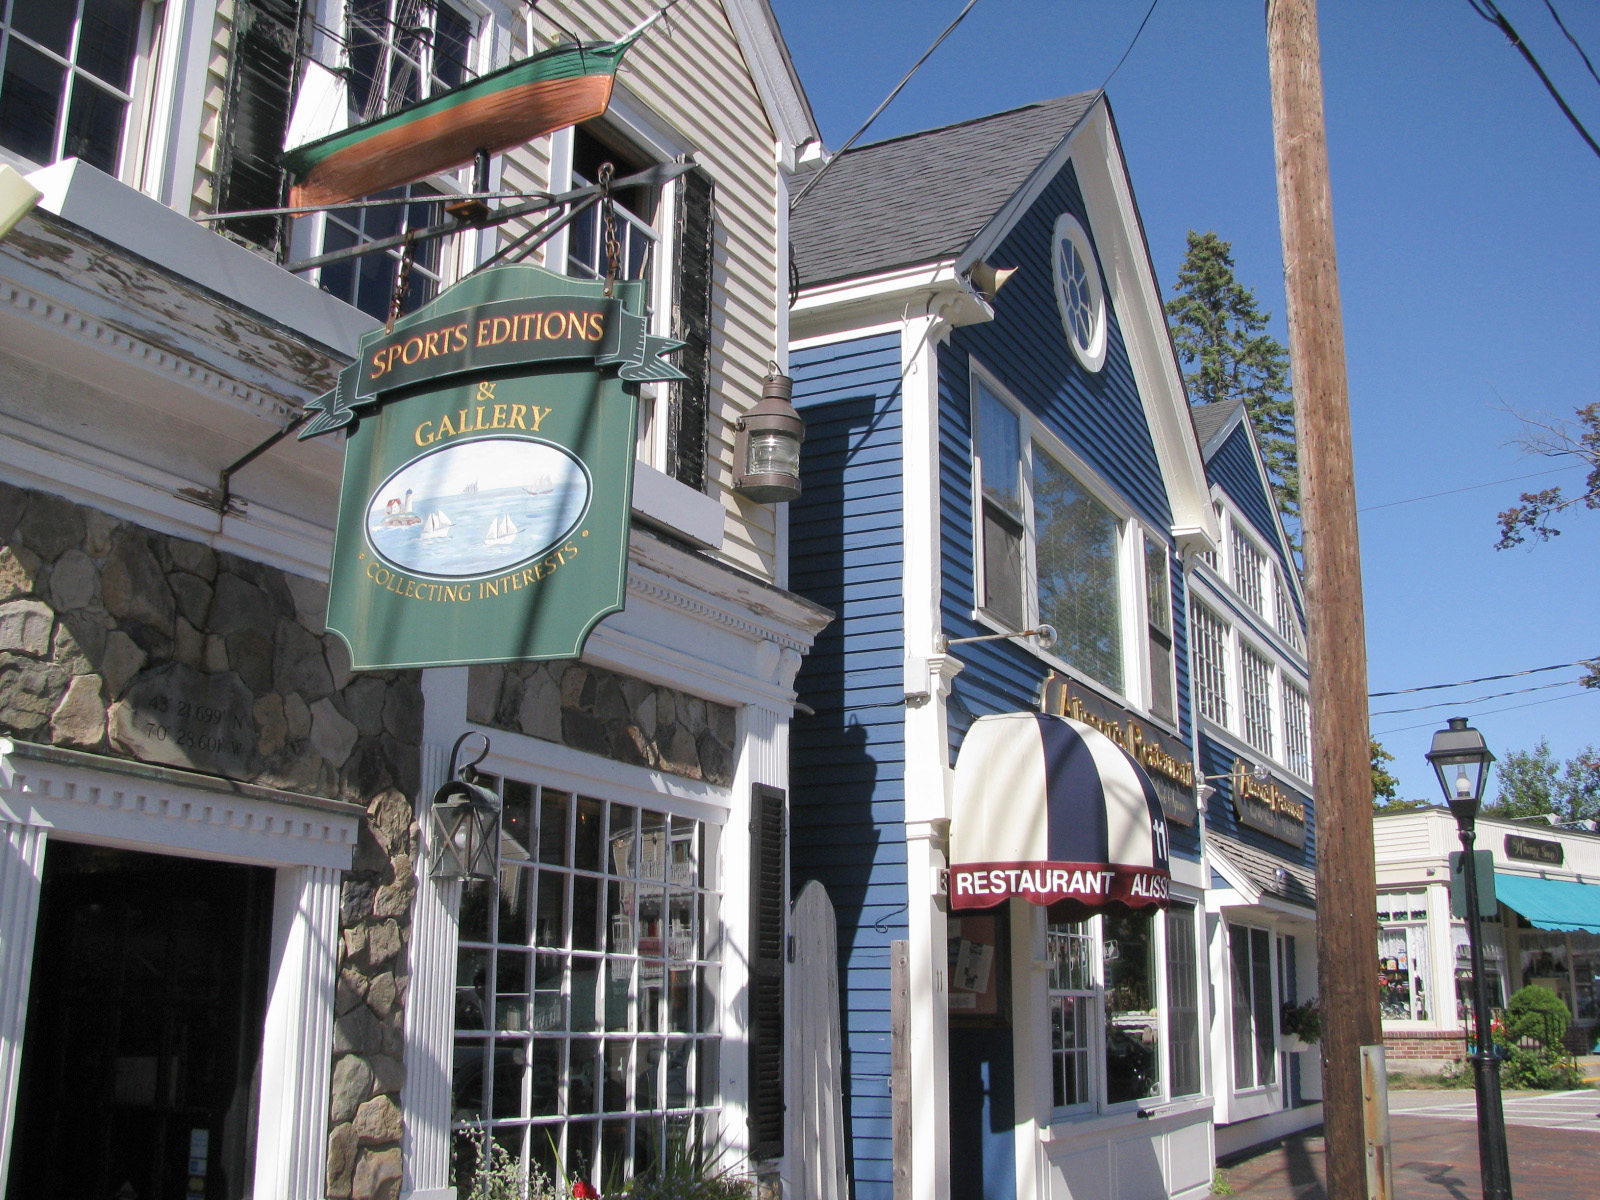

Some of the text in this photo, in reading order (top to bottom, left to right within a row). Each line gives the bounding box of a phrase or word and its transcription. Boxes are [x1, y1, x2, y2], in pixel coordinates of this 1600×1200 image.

[369, 311, 605, 380] SPORTS EDITIONS
[476, 380, 497, 402] &
[414, 403, 552, 447] GALLERY
[365, 540, 578, 602] COLLECTING INTERESTS
[956, 868, 1116, 896] RESTAURANT
